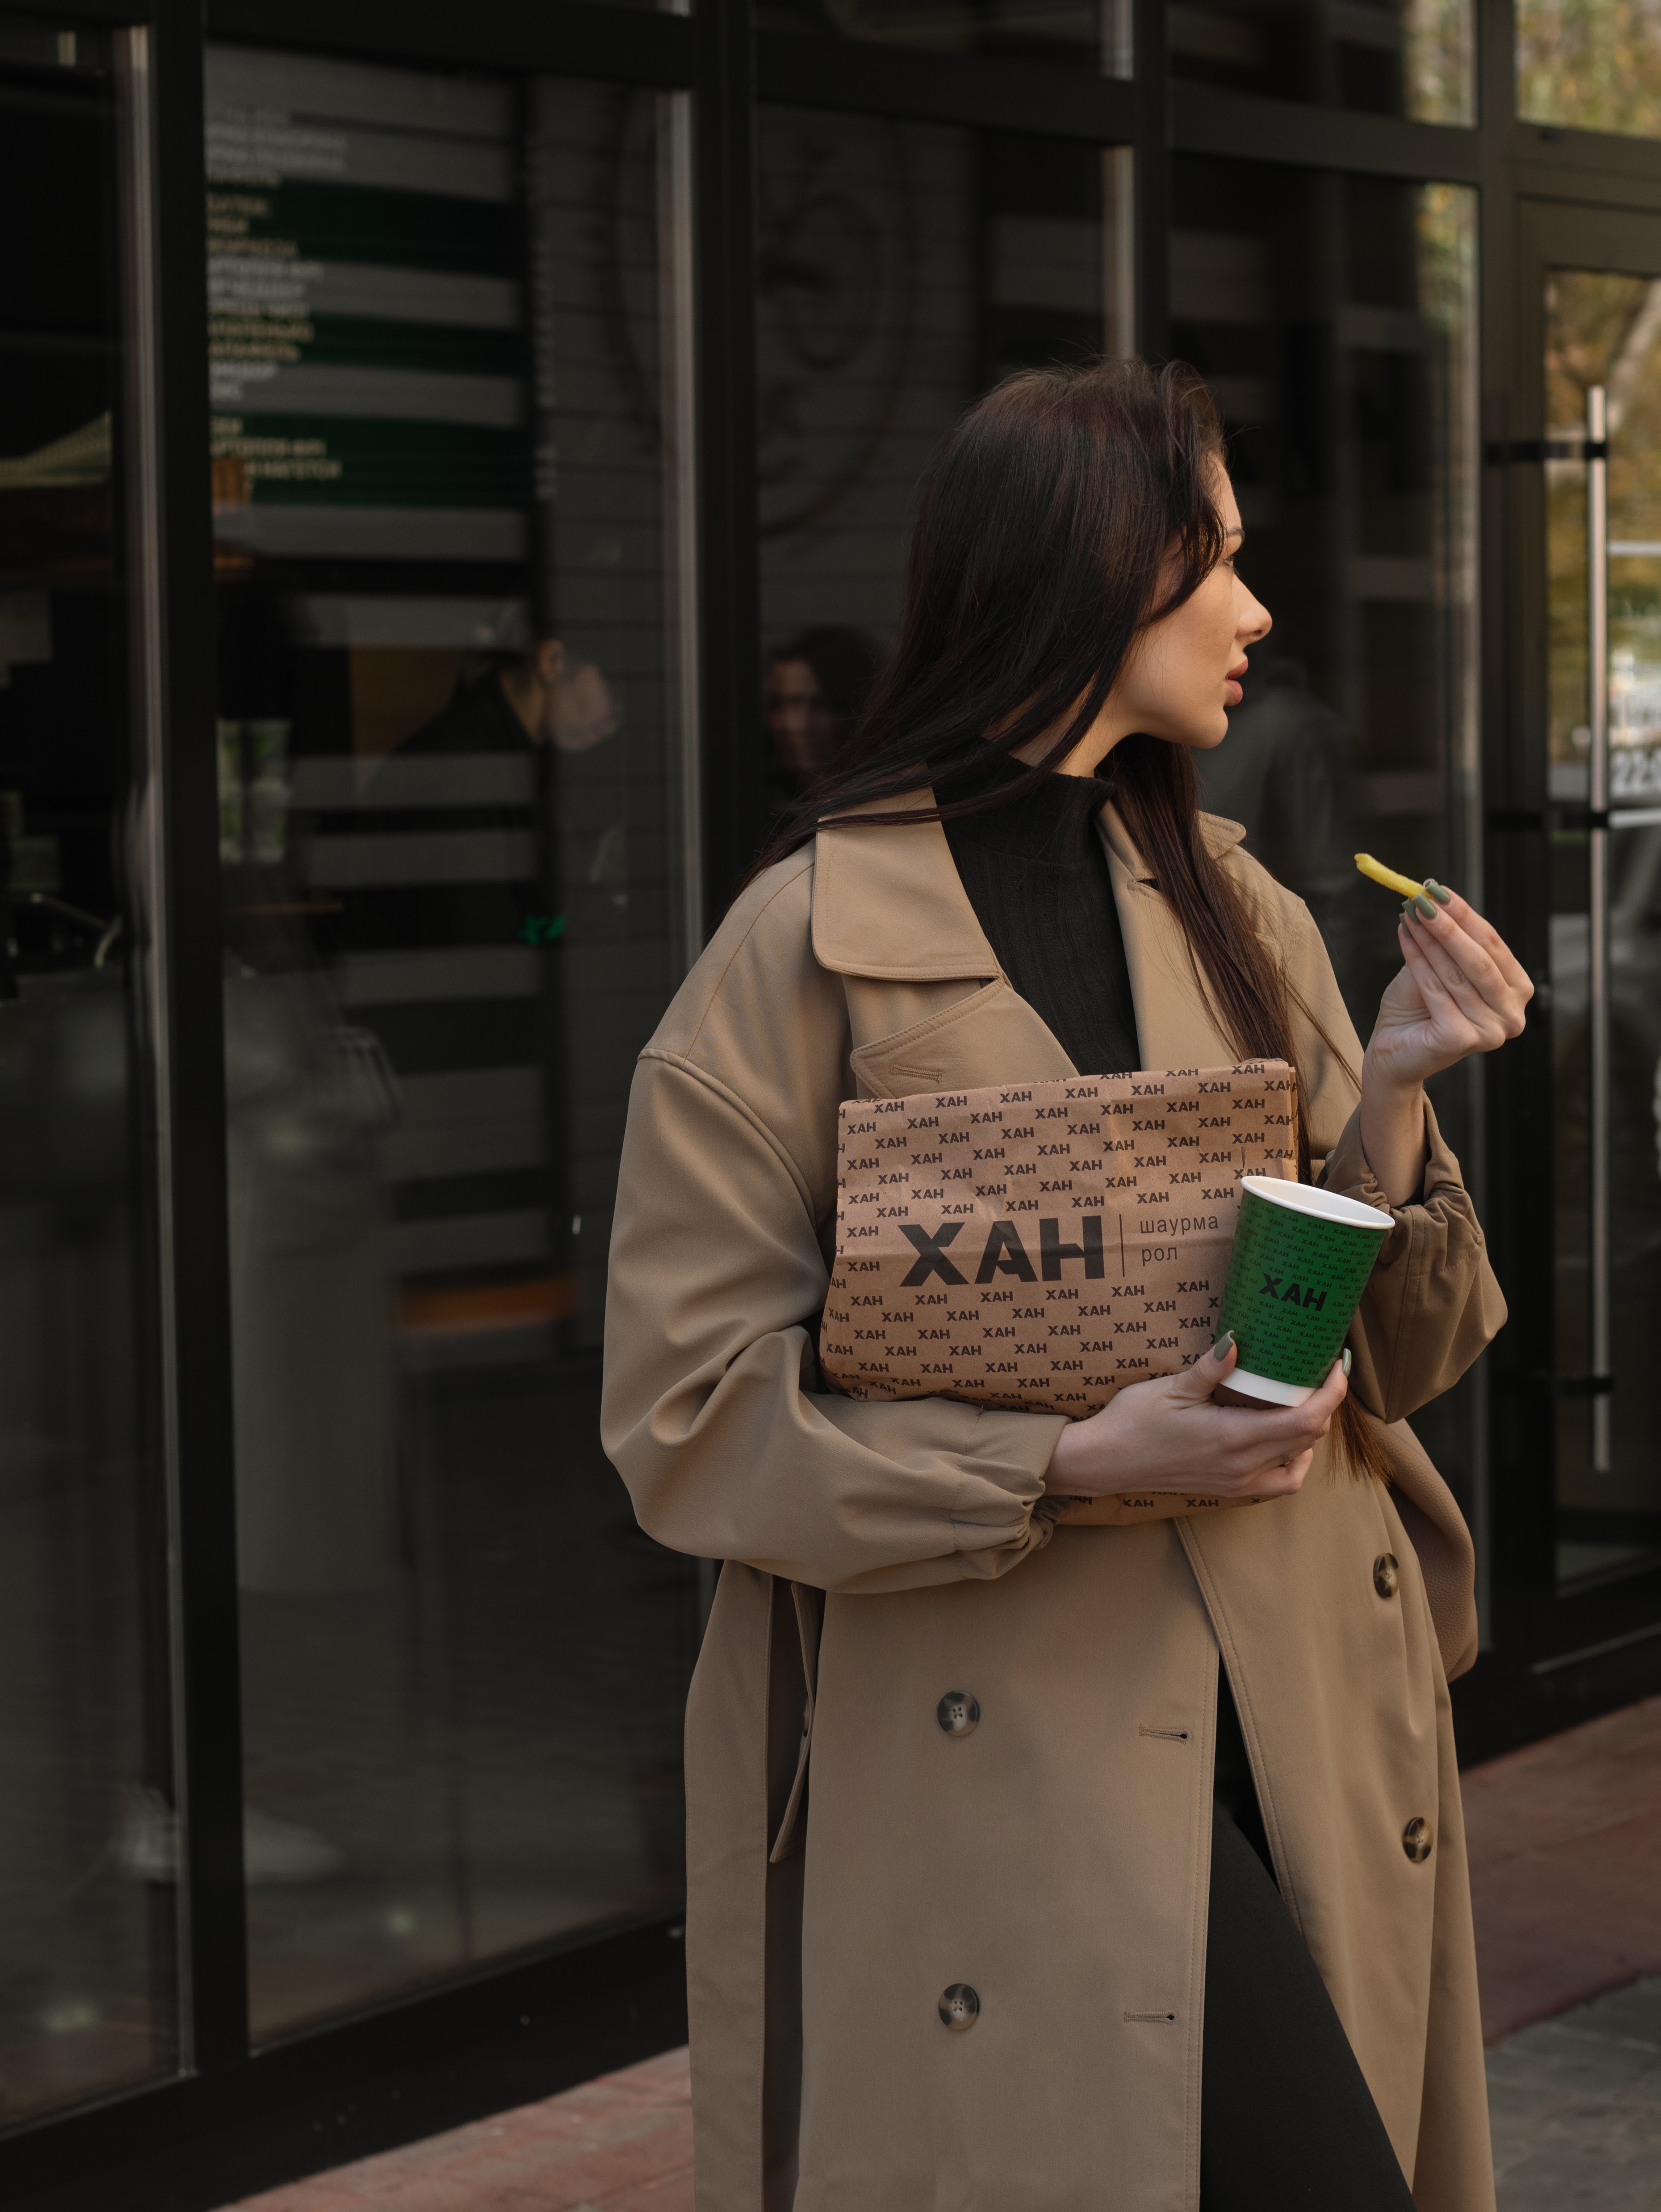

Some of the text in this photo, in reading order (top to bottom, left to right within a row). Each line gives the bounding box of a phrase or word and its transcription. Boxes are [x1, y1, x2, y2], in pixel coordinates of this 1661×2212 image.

[1165, 1068, 1199, 1077] ХАН
[1231, 1064, 1265, 1074] ХАН
[874, 1101, 904, 1114] ХАН
[935, 1096, 967, 1108] ХАН
[999, 1091, 1032, 1103] ХАН
[1064, 1087, 1098, 1099] ХАН
[1131, 1084, 1164, 1096] ХАН
[1197, 1082, 1231, 1093] ХАН
[847, 1098, 1265, 1135] ХАН ХАН ХАН ХАН ХАН ХАН ХАН
[874, 1136, 907, 1150] ХАН
[938, 1131, 970, 1144] ХАН
[1001, 1127, 1034, 1139] ХАН
[1066, 1123, 1100, 1135] ХАН
[1132, 1120, 1165, 1132] ХАН
[1198, 1116, 1231, 1128] ХАН
[846, 1132, 1265, 1171] ХАН ХАН ХАН ХАН ХАН ХАН ХАН
[877, 1149, 1293, 1185] ХАН ХАН ХАН ХАН ХАН ХАН ХАН
[848, 1192, 880, 1205] ХАН
[911, 1188, 944, 1199] ХАН
[975, 1184, 1007, 1197] ХАН
[1039, 1180, 1073, 1192] ХАН
[1105, 1176, 1137, 1188] ХАН
[1168, 1172, 1201, 1184] ХАН
[876, 1187, 1234, 1218] ХАН ХАН ХАН ХАН ХАН ХАН
[846, 1226, 879, 1238] ХАН
[1140, 1216, 1218, 1237] шаурма
[1269, 1218, 1283, 1227] ХАН
[1292, 1226, 1309, 1235] ХАН
[1317, 1233, 1335, 1242] ХАН
[1282, 1214, 1350, 1237] ХАН ХАН ХАН
[1277, 1231, 1294, 1240] ХАН
[1301, 1239, 1319, 1248] ХАН
[897, 1215, 1105, 1287] ХАН
[1264, 1236, 1279, 1245] ХАН
[1287, 1244, 1304, 1253] ХАН
[1312, 1251, 1330, 1260] ХАН
[1141, 1246, 1177, 1267] рол
[1273, 1249, 1289, 1257] ХАН
[1296, 1256, 1314, 1265] ХАН
[846, 1261, 881, 1272] ХАН
[1268, 1266, 1284, 1275] ХАН
[1292, 1274, 1309, 1282] ХАН
[1282, 1261, 1299, 1270] ХАН
[1306, 1268, 1324, 1277] ХАН
[830, 1277, 846, 1289] АН
[850, 1280, 1210, 1306] ХАН ХАН ХАН ХАН ХАН ХАН
[1258, 1273, 1328, 1312] ХАН
[828, 1300, 1176, 1323] ХАН ХАН ХАН ХАН ХАН ХАН
[1259, 1301, 1274, 1310] ХАН
[1281, 1308, 1298, 1316] ХАН
[853, 1316, 1211, 1340] ХАН ХАН ХАН ХАН ХАН ХАН
[1254, 1318, 1270, 1327] ХАН
[1277, 1325, 1293, 1333] ХАН
[1268, 1313, 1284, 1322] ХАН
[1290, 1320, 1307, 1328] ХАН
[1263, 1330, 1279, 1339] ХАН
[826, 1336, 1179, 1357] ХАН ХАН ХАН ХАН ХАН ХАН
[1250, 1335, 1265, 1344] ХАН
[1271, 1342, 1288, 1351] ХАН
[1246, 1353, 1260, 1361] ХАН
[1266, 1359, 1282, 1368] ХАН
[1258, 1347, 1274, 1356] ХАН
[1280, 1354, 1295, 1362] ХАН
[857, 1362, 890, 1373] ХАН
[920, 1363, 953, 1374] ХАН
[984, 1362, 1018, 1373] ХАН
[1050, 1360, 1083, 1371] ХАН
[1115, 1357, 1149, 1369] ХАН
[1254, 1365, 1268, 1373] ХАН
[1275, 1371, 1290, 1379] ХАН
[868, 1381, 897, 1395] ХАН
[890, 1375, 1115, 1388] ХАН ХАН ХАН ХАН
[1053, 1392, 1087, 1402] ХАН
[1023, 1401, 1055, 1410] ХАН
[1122, 1498, 1219, 1508] ХАН ХАН
